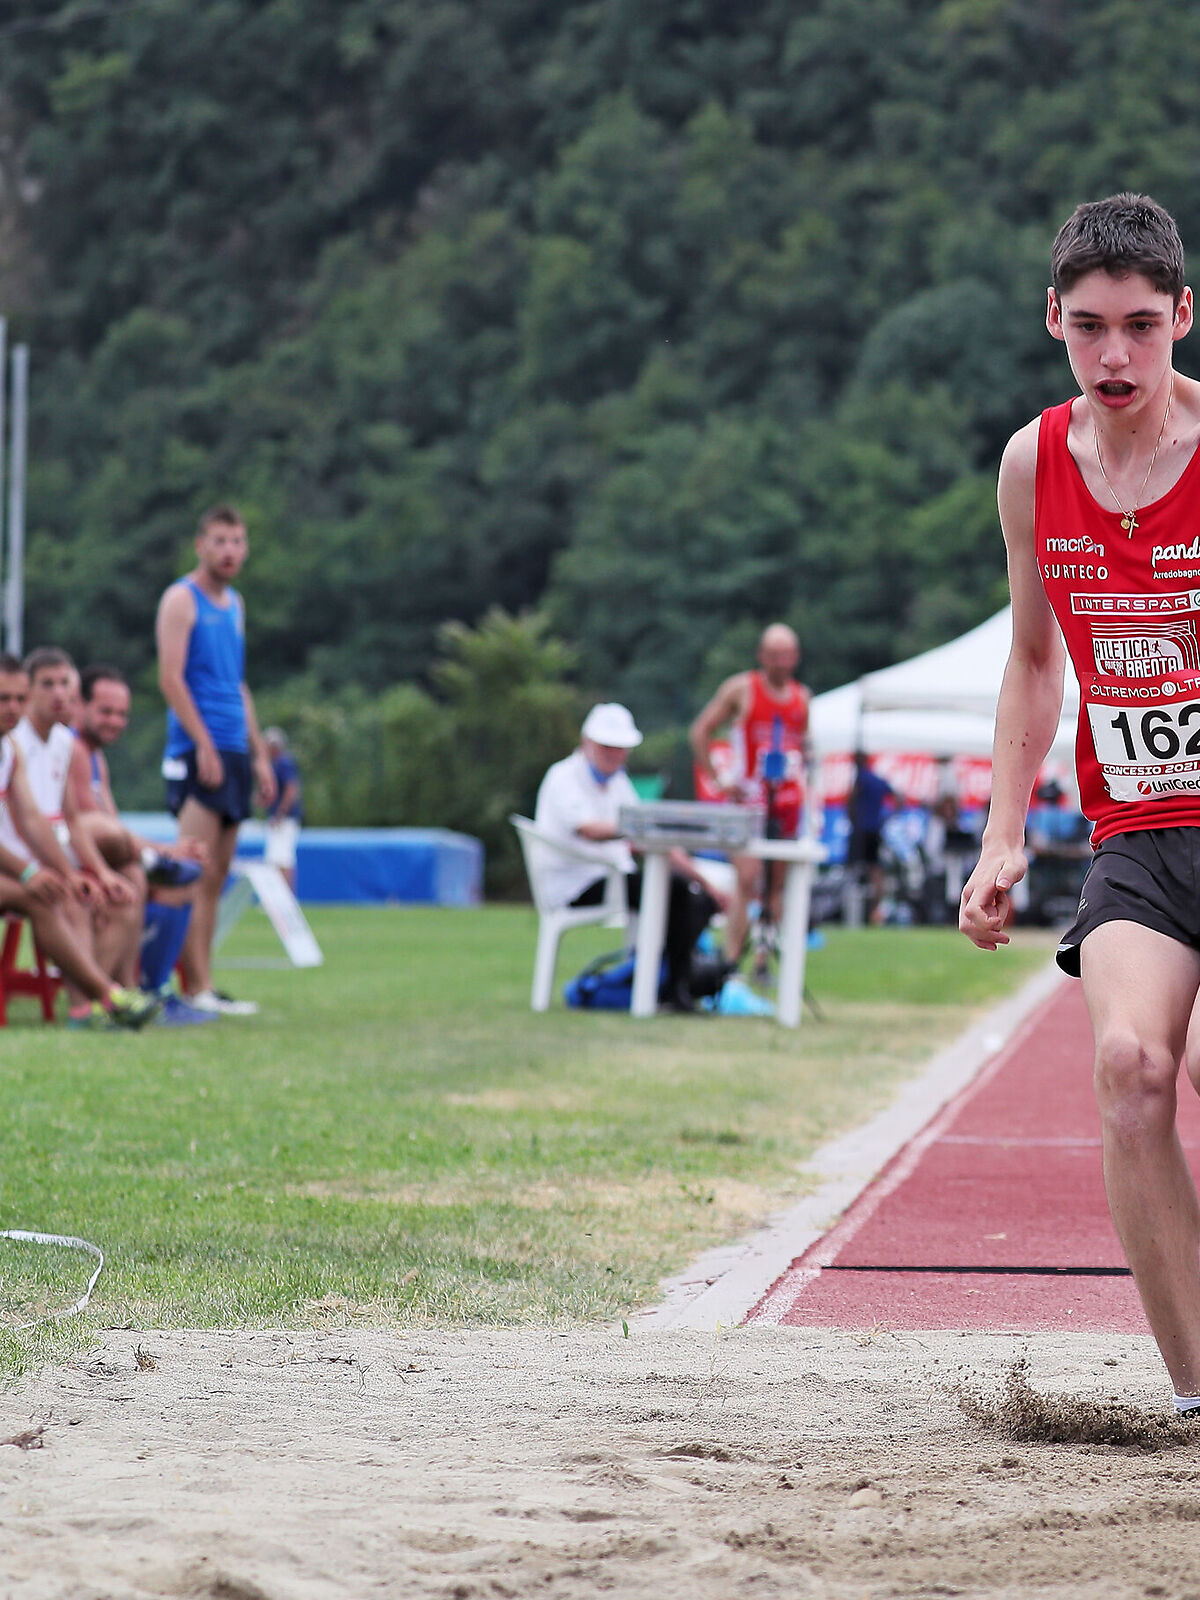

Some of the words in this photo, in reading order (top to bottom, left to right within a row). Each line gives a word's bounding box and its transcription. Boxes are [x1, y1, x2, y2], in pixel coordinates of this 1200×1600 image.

[1044, 564, 1109, 580] SURTECO
[1080, 597, 1188, 610] INTERSPAR
[1095, 639, 1150, 659] ATLETICA
[1125, 657, 1177, 678] BRENTA
[1103, 764, 1163, 776] CONCESIO
[1165, 762, 1199, 773] 2021
